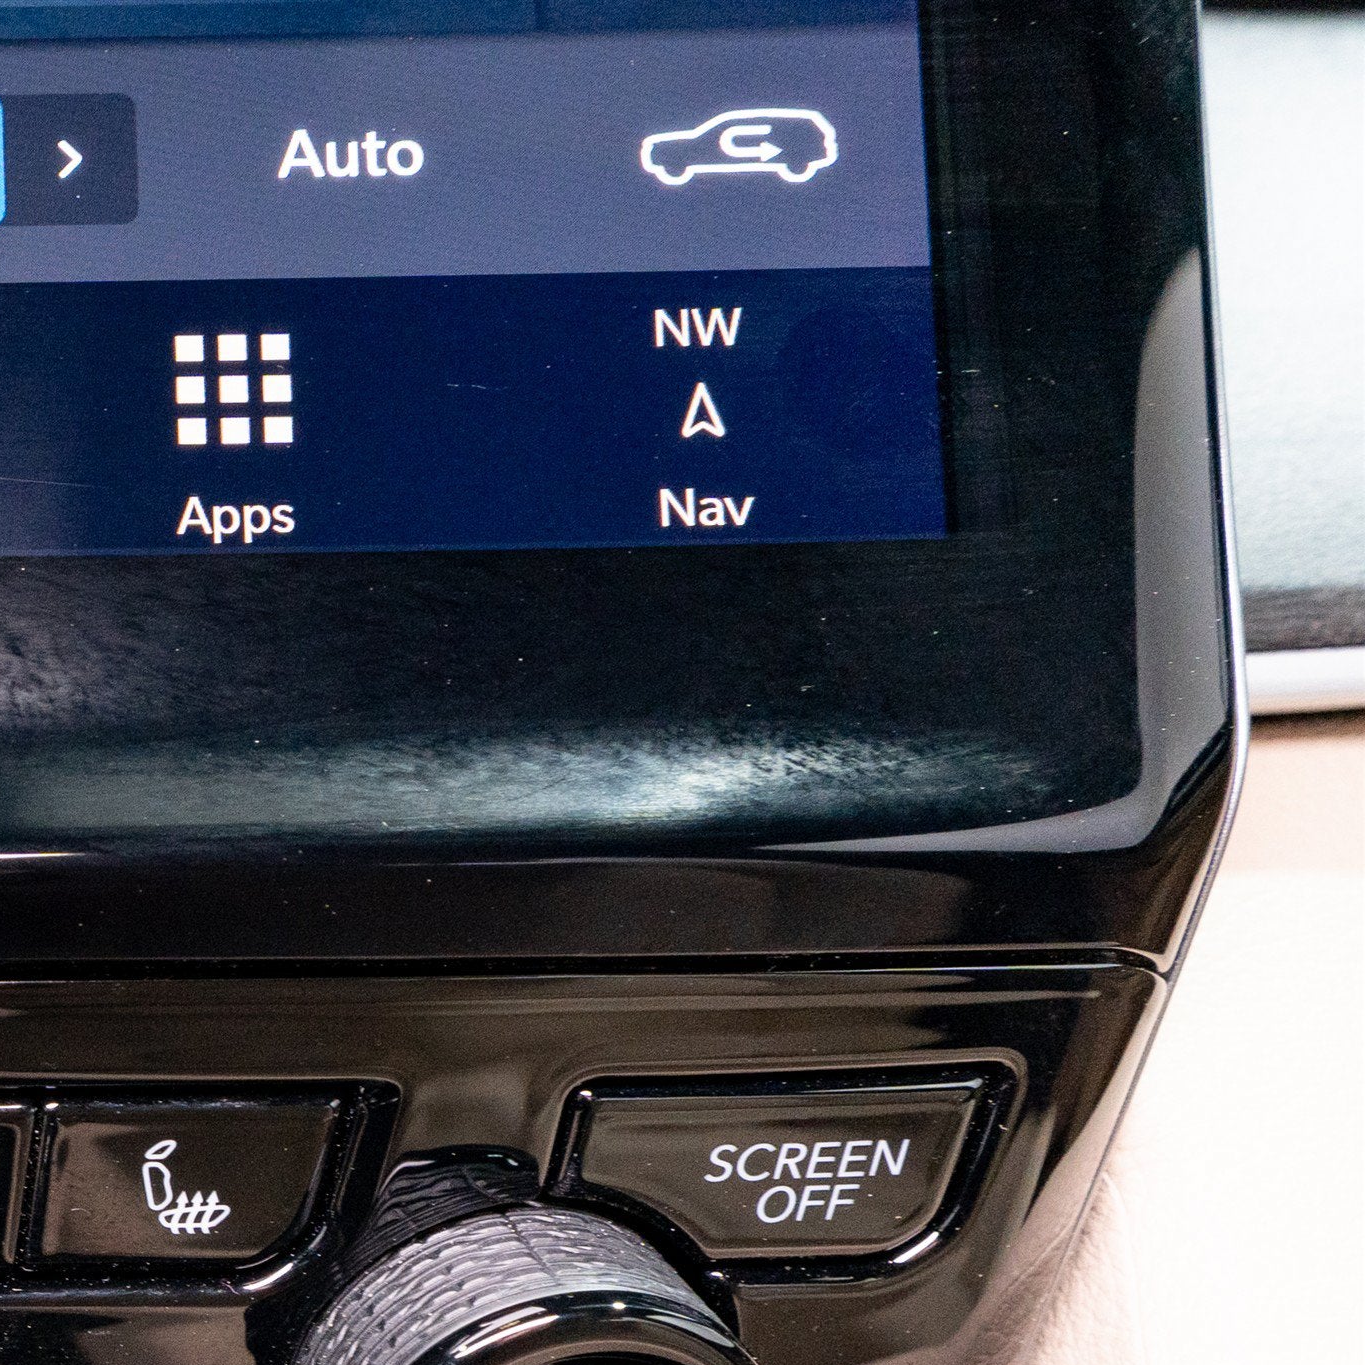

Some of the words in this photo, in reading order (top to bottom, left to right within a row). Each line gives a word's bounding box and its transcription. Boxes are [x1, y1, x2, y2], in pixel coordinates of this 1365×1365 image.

[278, 129, 424, 179] Auto
[655, 308, 741, 347] NW
[177, 496, 295, 544] Apps
[660, 488, 755, 527] Nav
[704, 1139, 910, 1183] SCREEN
[756, 1186, 856, 1223] OFF
